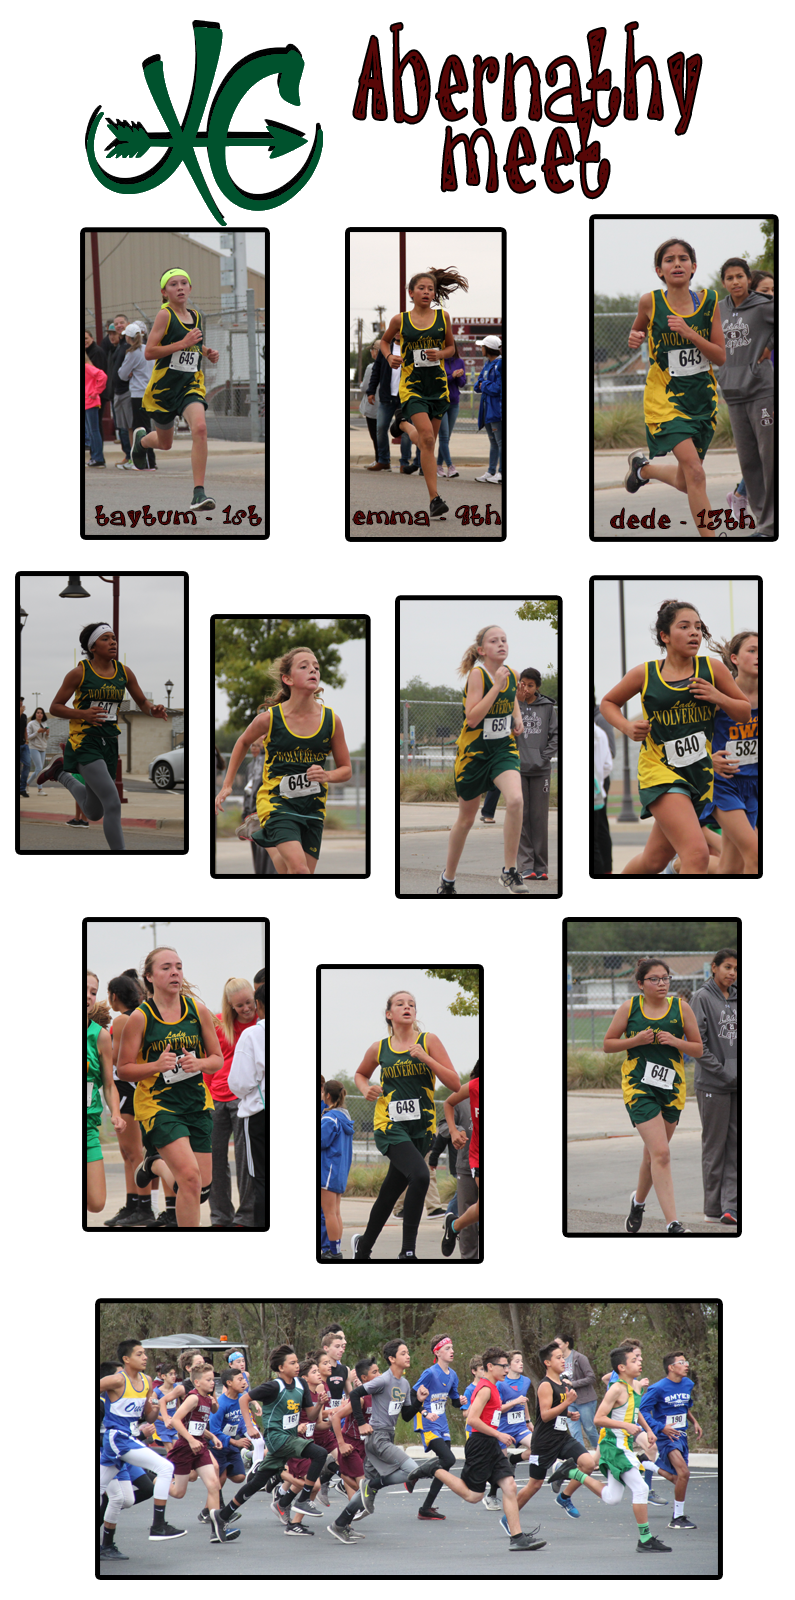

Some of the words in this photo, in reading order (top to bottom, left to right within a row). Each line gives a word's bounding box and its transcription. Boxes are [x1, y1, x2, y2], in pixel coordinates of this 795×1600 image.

[179, 352, 195, 365] 645
[679, 349, 702, 367] 643
[671, 700, 697, 709] Lady
[729, 723, 758, 740] OW
[675, 735, 700, 757] 640
[735, 740, 757, 756] 582
[288, 773, 311, 791] 649
[165, 1030, 186, 1039] Lady
[651, 1064, 669, 1082] 641
[396, 1100, 415, 1114] 648
